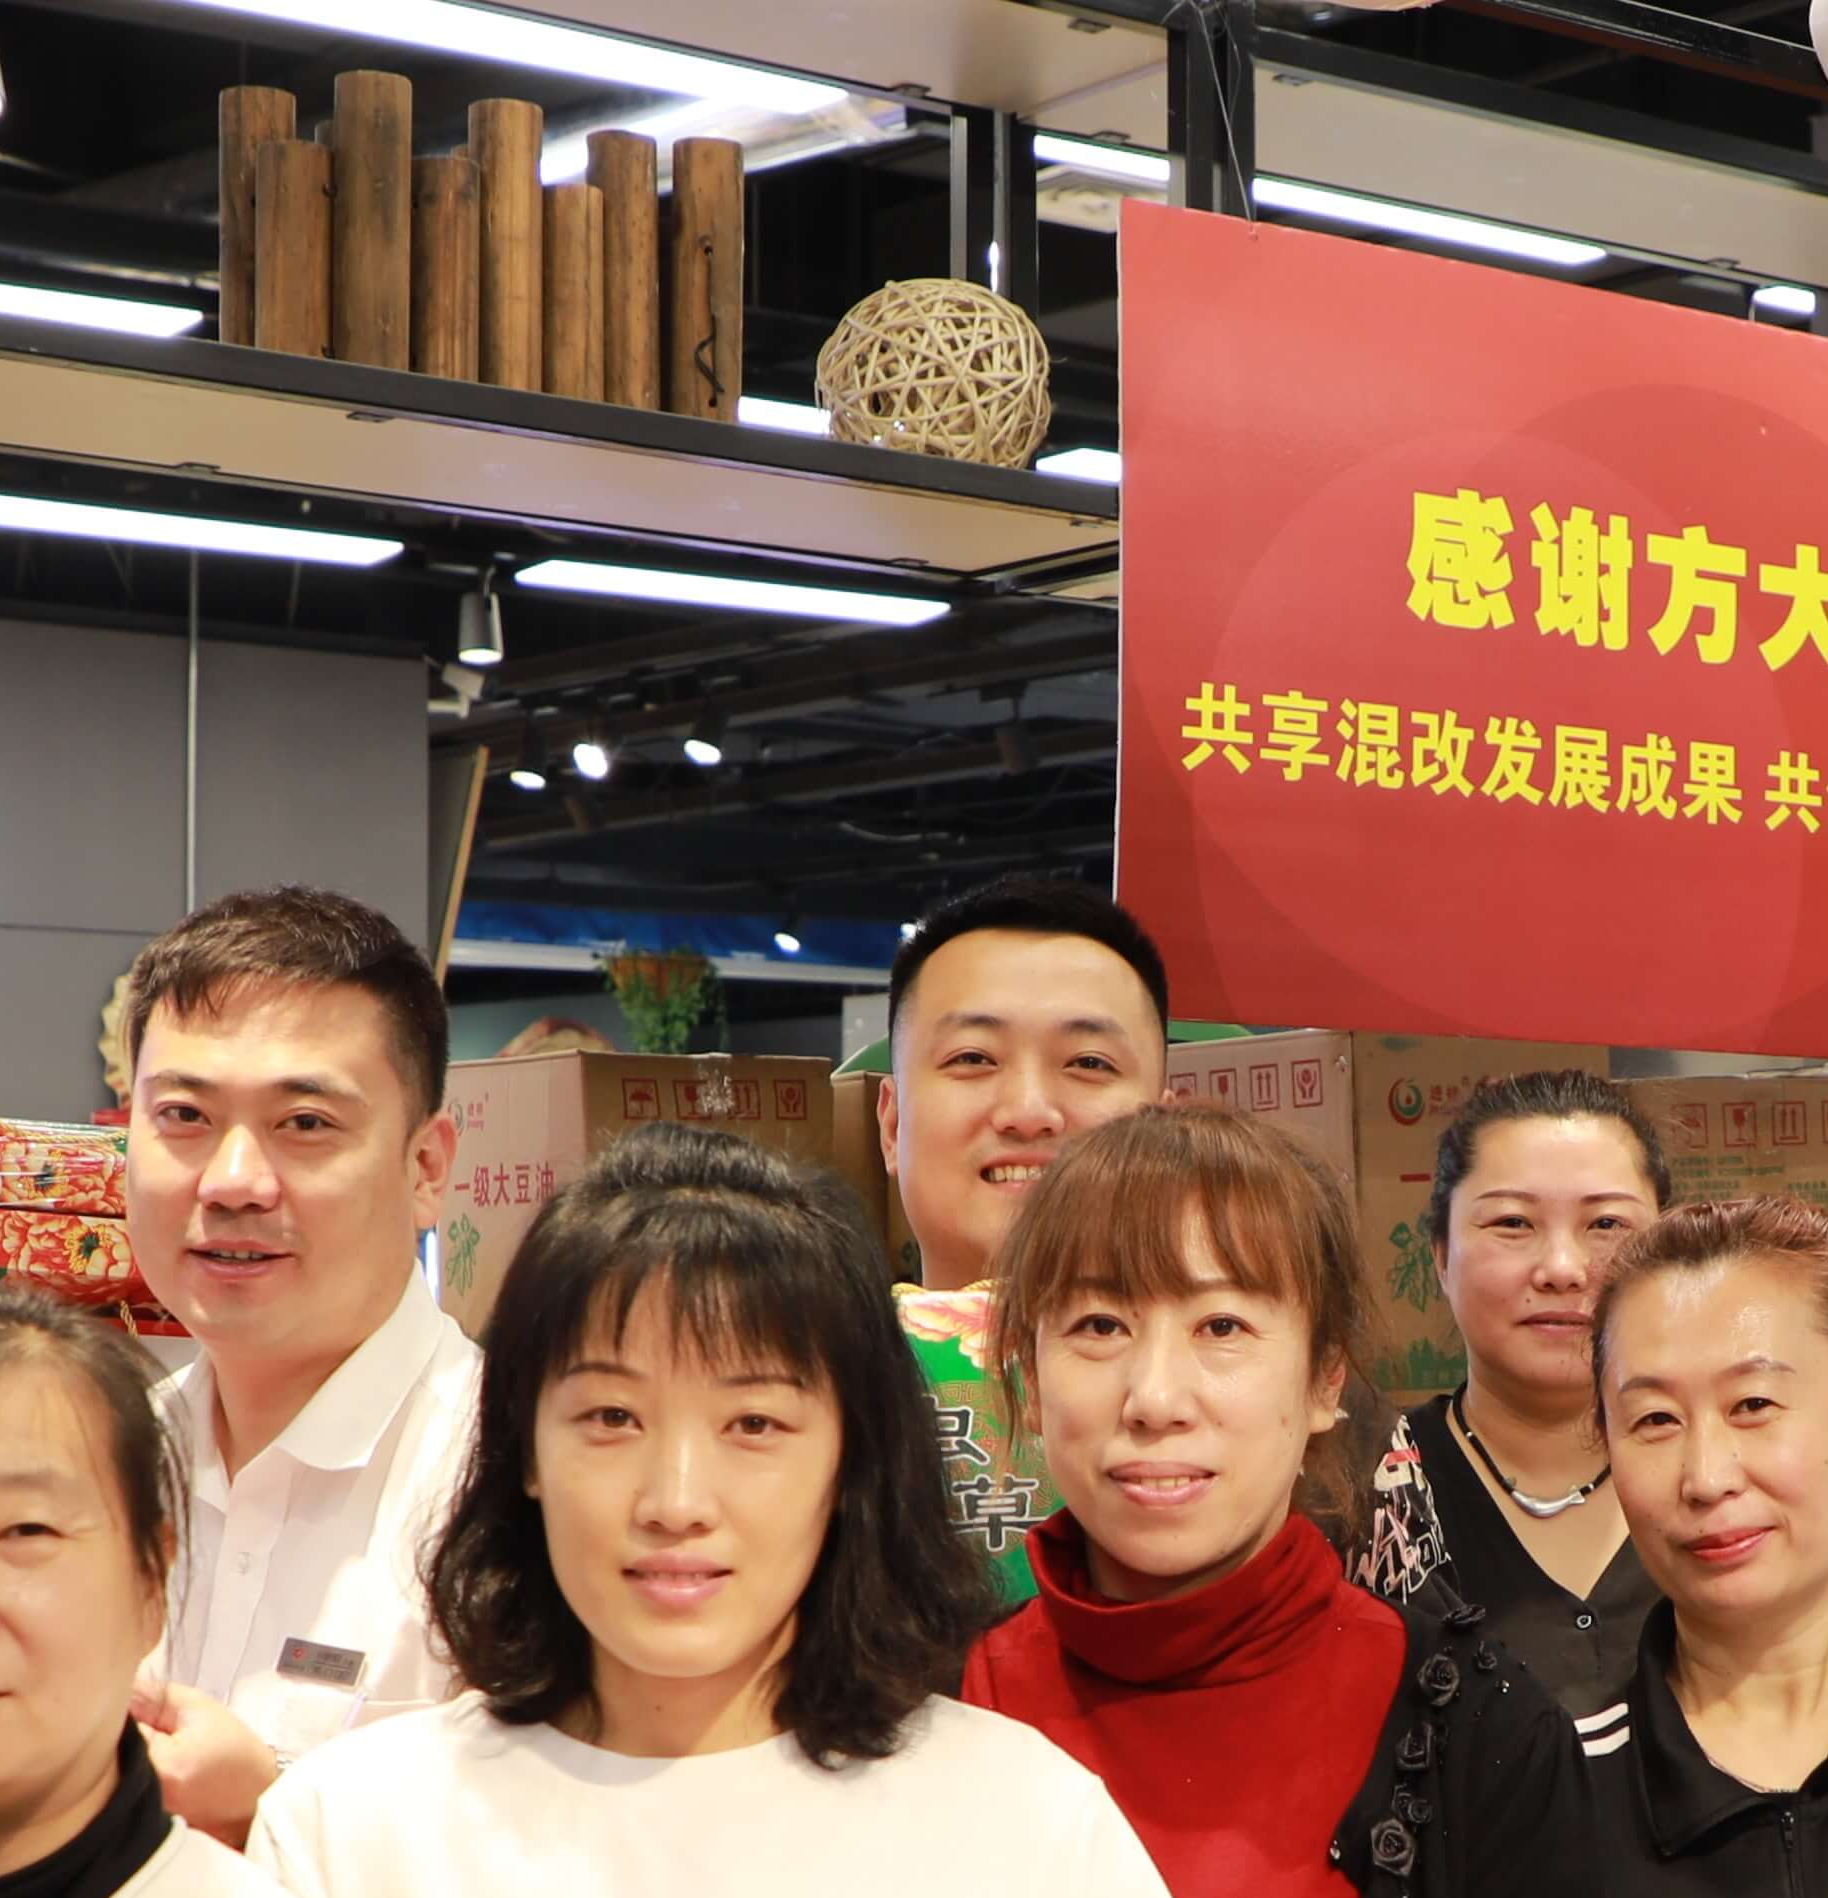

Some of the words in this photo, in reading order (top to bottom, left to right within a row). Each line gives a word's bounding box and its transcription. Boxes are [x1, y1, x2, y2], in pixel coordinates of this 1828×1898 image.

[1180, 682, 1744, 826] 共享混改发展成果
[454, 1161, 555, 1208] 一级大豆油
